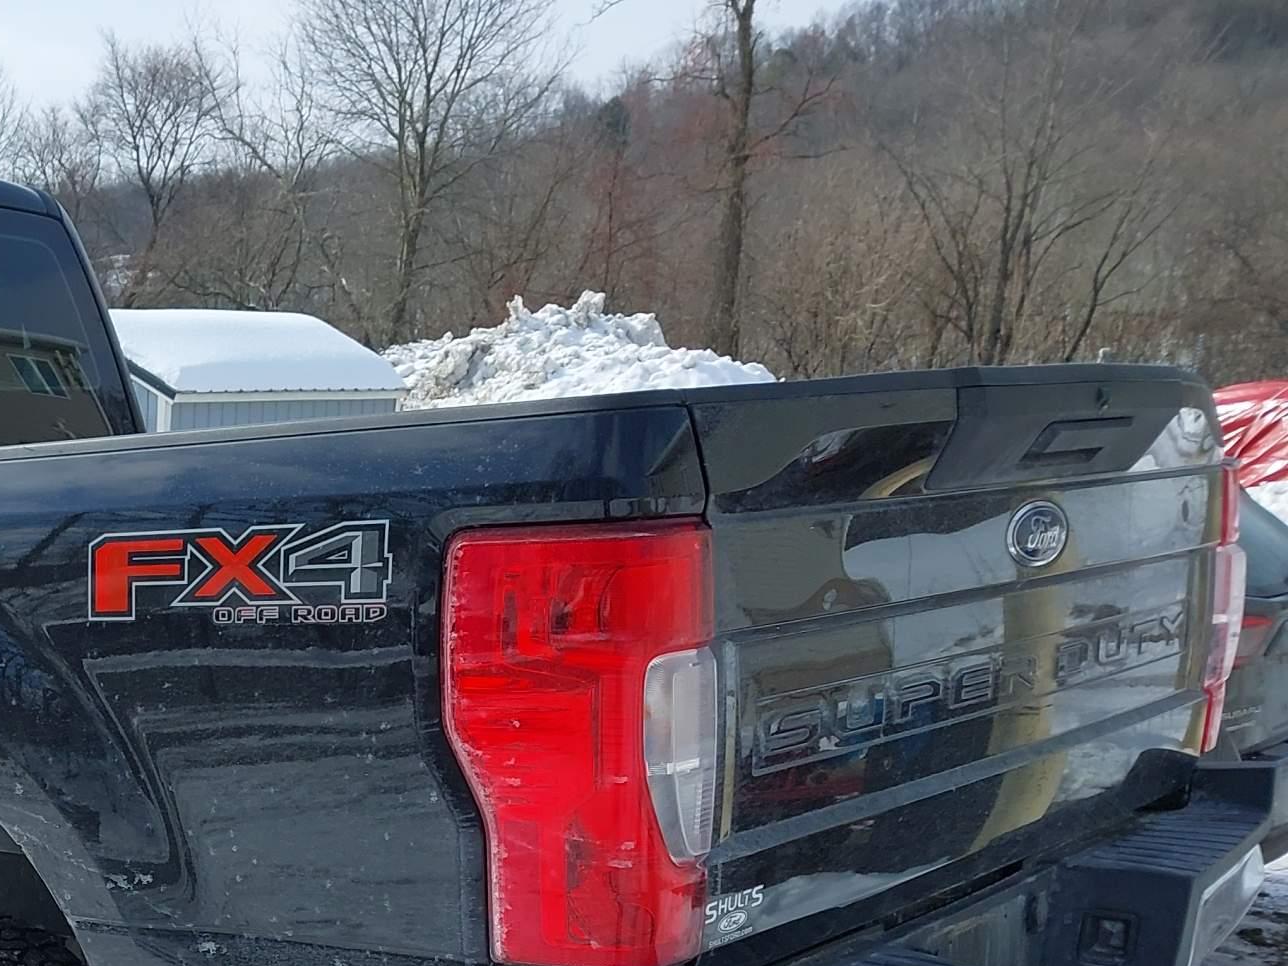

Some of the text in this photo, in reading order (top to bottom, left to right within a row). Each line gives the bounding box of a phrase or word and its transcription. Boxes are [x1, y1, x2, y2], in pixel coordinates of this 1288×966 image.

[1027, 515, 1060, 550] Ford
[88, 519, 393, 621] FX4
[213, 604, 388, 625] OFF ROAD
[759, 611, 1184, 755] SUPER DUTY
[704, 884, 765, 925] SHULTS
